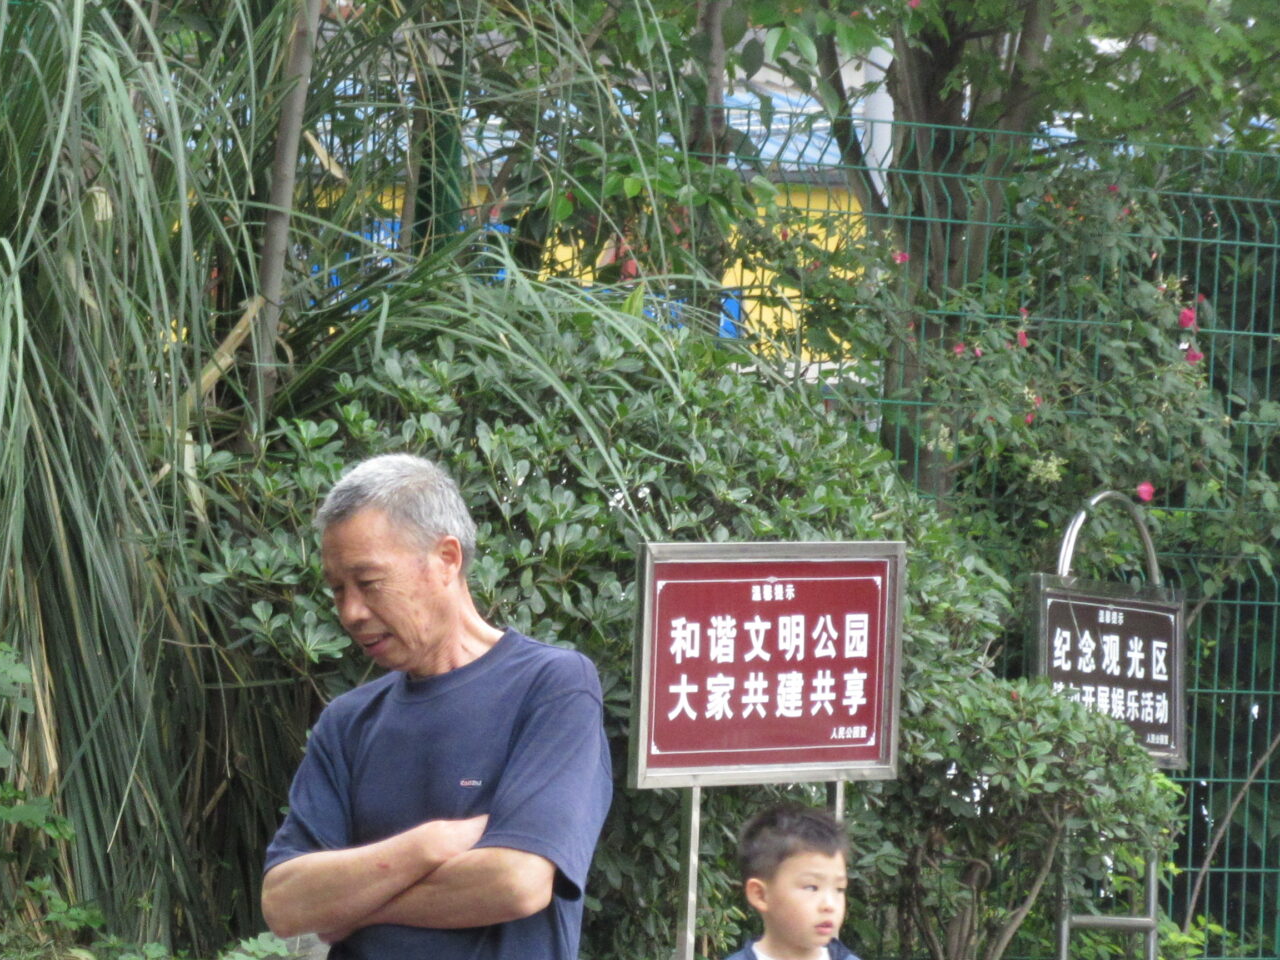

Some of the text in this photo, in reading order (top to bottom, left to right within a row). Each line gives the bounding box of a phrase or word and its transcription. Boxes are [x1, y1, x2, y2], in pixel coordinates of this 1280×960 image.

[670, 613, 869, 664] 和谐文明公园
[1053, 627, 1169, 681] 纪念观光区
[667, 668, 868, 721] 大家共建共享
